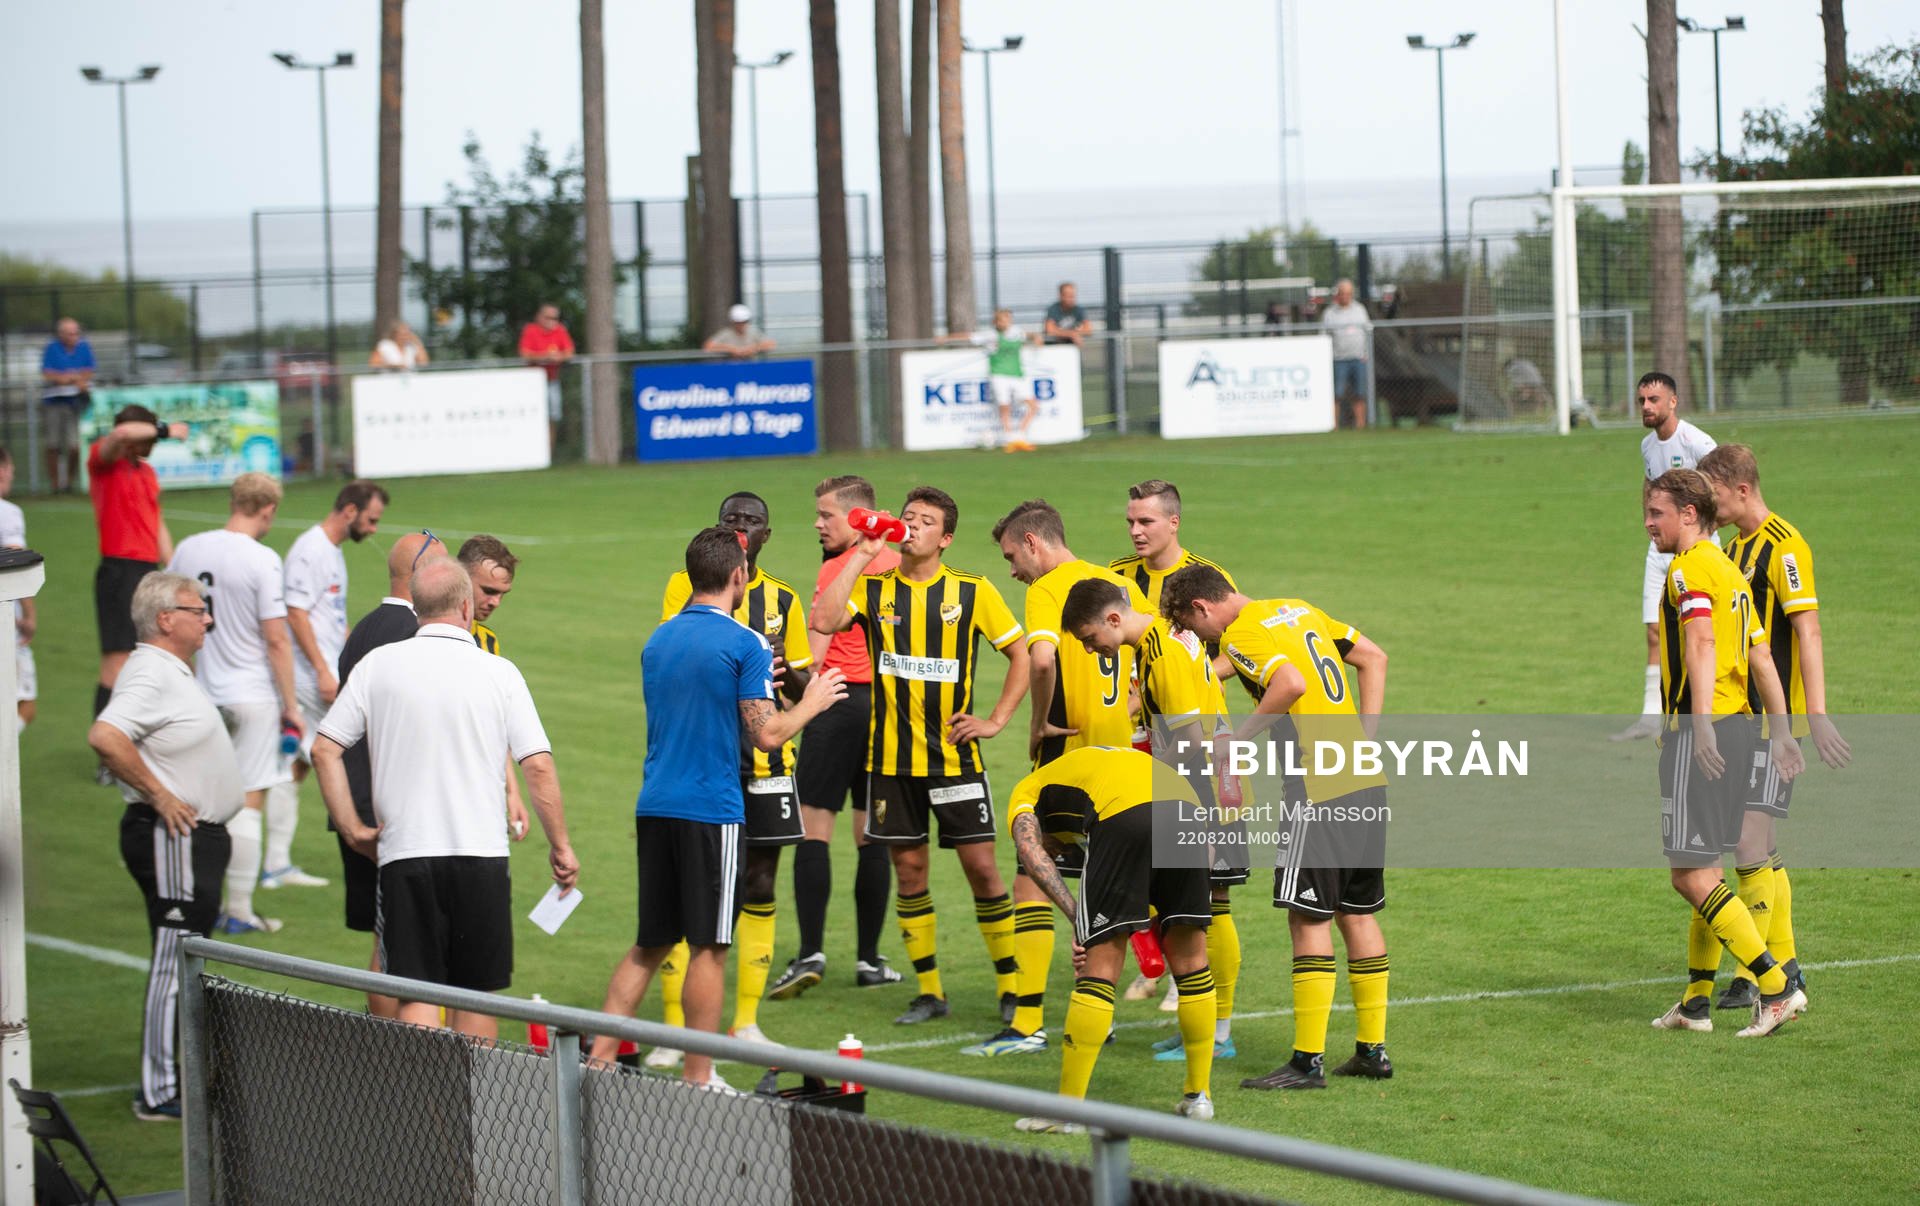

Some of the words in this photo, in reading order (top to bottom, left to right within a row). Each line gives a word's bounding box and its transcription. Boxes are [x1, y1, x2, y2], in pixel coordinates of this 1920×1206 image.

[734, 381, 812, 405] Marcus
[651, 411, 732, 440] Edward
[732, 411, 750, 435] &
[752, 410, 803, 438] Tage
[882, 653, 953, 675] Ballingslöv
[1304, 630, 1345, 704] 6
[1096, 649, 1120, 707] 9
[780, 797, 791, 819] 5
[979, 802, 989, 824] 3
